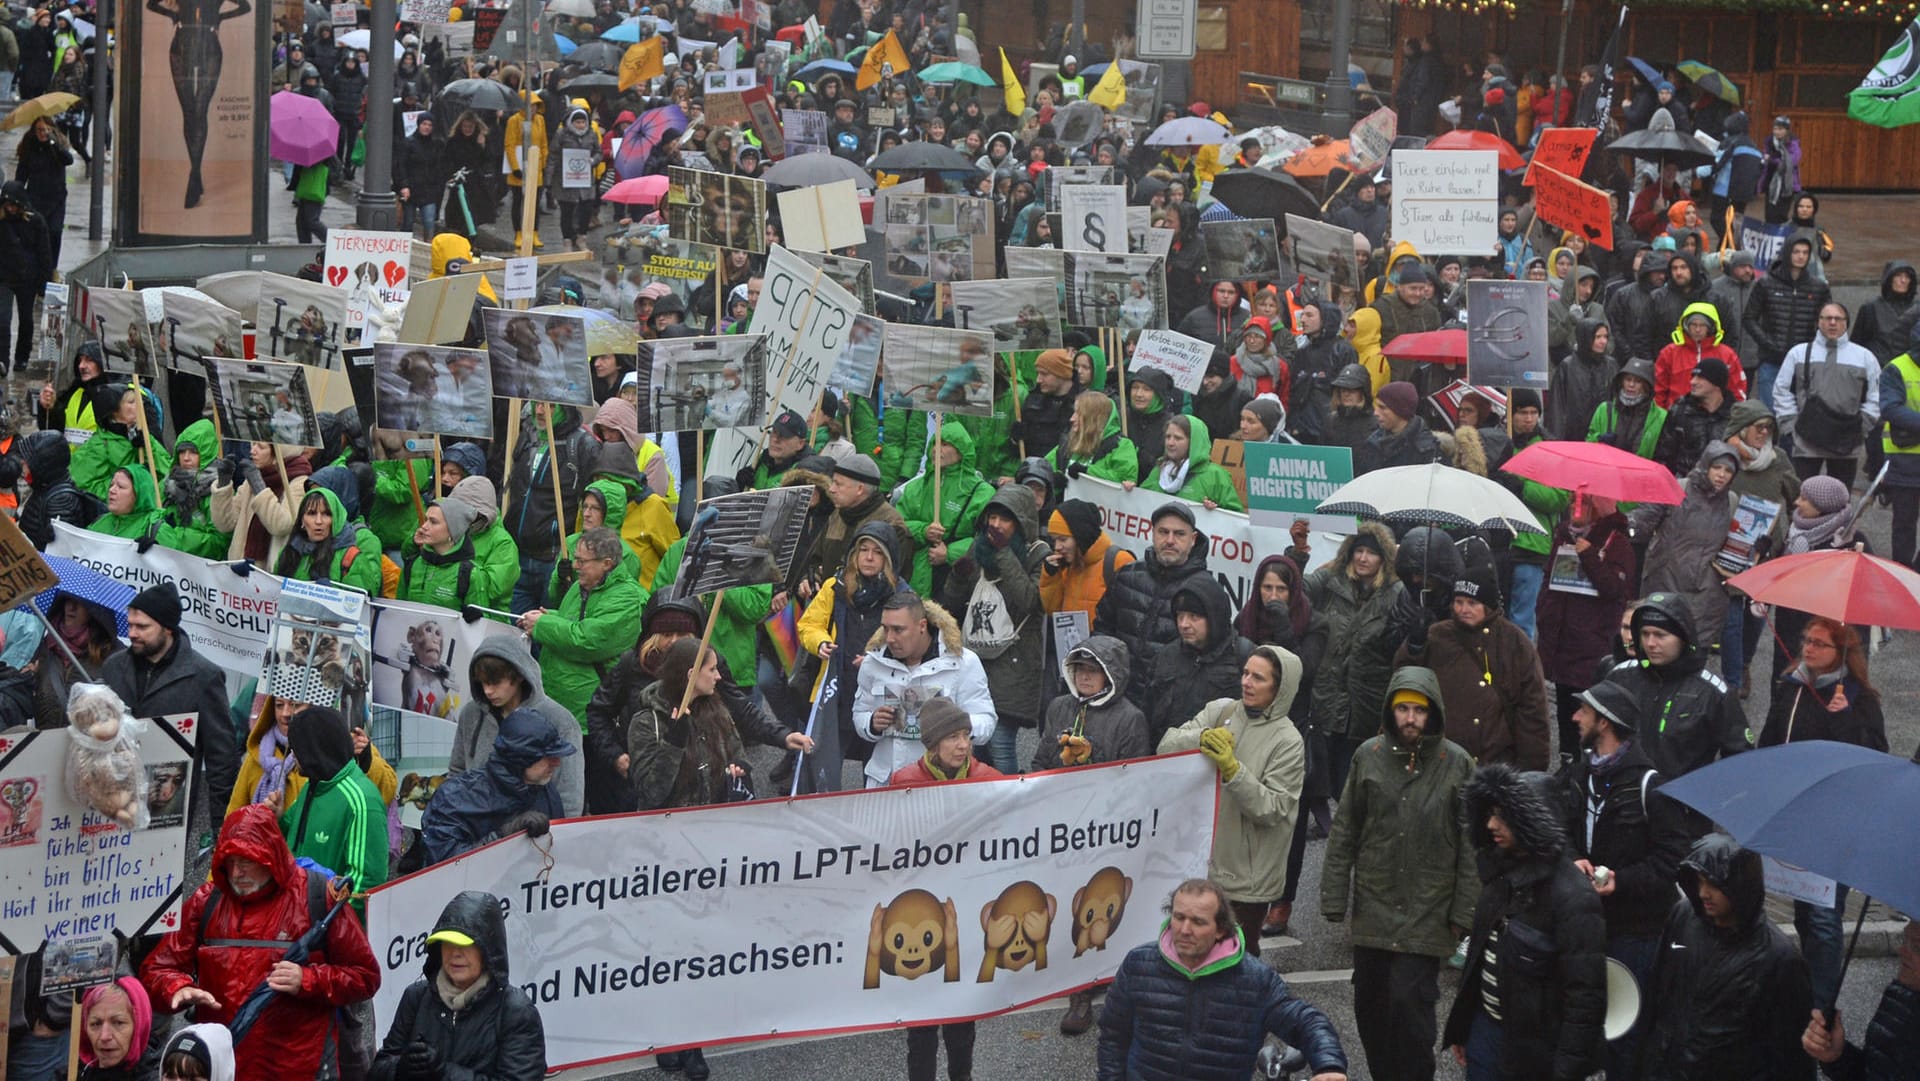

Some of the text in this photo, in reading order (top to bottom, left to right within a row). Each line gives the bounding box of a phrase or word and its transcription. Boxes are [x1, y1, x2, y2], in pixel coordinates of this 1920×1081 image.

[1397, 162, 1428, 176] Tiere
[1435, 162, 1470, 176] einfach
[1406, 183, 1416, 194] in
[1418, 181, 1442, 194] Ruhe
[1438, 208, 1454, 222] als
[333, 236, 408, 253] TIERVERSUCHE
[1424, 229, 1465, 245] Wesen
[650, 254, 695, 269] STOPPT
[380, 288, 404, 303] HELL
[1147, 328, 1170, 346] Verbot
[1221, 445, 1246, 468] L
[1268, 457, 1328, 480] ANIMAL
[1250, 477, 1304, 499] RIGHTS
[1210, 535, 1254, 564] TOD
[0, 558, 48, 604] STING
[180, 578, 218, 603] OHNE
[181, 595, 273, 635] ORE SCHLI
[51, 812, 109, 831] Ich blu
[47, 837, 88, 860] fühle
[99, 832, 130, 849] und
[521, 866, 727, 917] Tierquälerei
[739, 856, 780, 886] im
[793, 838, 969, 880] LPT-Labor
[979, 827, 1040, 861] und
[1050, 816, 1142, 854] Betrug
[1150, 808, 1160, 837] !
[44, 866, 69, 887] bin
[4, 874, 174, 919] Hört ihr mich nicht
[44, 912, 116, 940] weinen
[573, 940, 844, 999] Niedersachsen:
